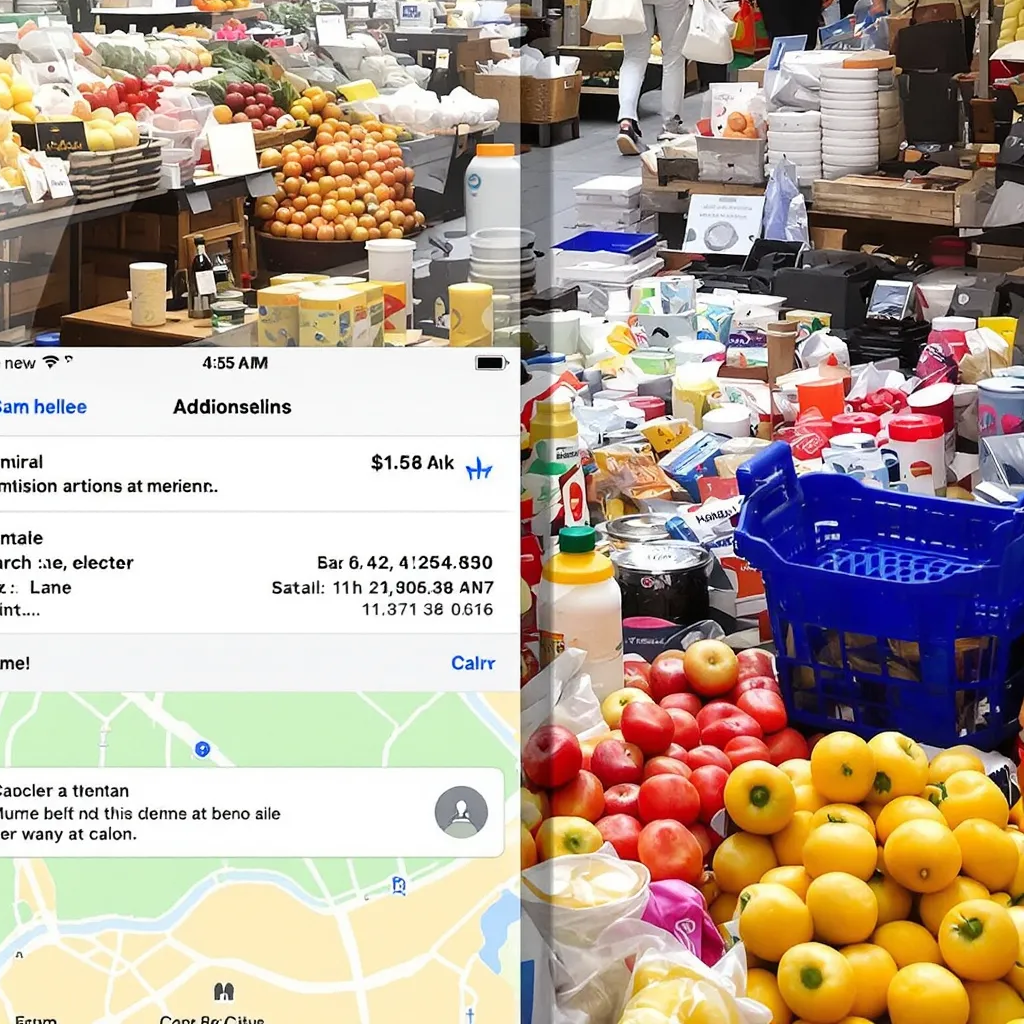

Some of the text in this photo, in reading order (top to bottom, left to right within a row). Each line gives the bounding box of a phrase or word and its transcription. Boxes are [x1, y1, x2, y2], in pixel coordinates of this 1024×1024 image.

[5, 359, 37, 370] new
[202, 355, 269, 370] 4:55 AM
[34, 398, 88, 415] hellee
[371, 453, 423, 472] $1.58
[63, 478, 123, 494] artions
[128, 479, 144, 493] at
[72, 554, 135, 570] electer
[30, 579, 72, 595] Lane
[333, 579, 363, 595] 11h
[459, 580, 495, 595] AN7
[58, 786, 68, 798] a
[104, 806, 133, 821] this
[192, 807, 208, 821] at
[212, 806, 251, 821] beno
[22, 829, 64, 844] wany
[69, 828, 84, 841] at
[89, 825, 137, 841] calon.
